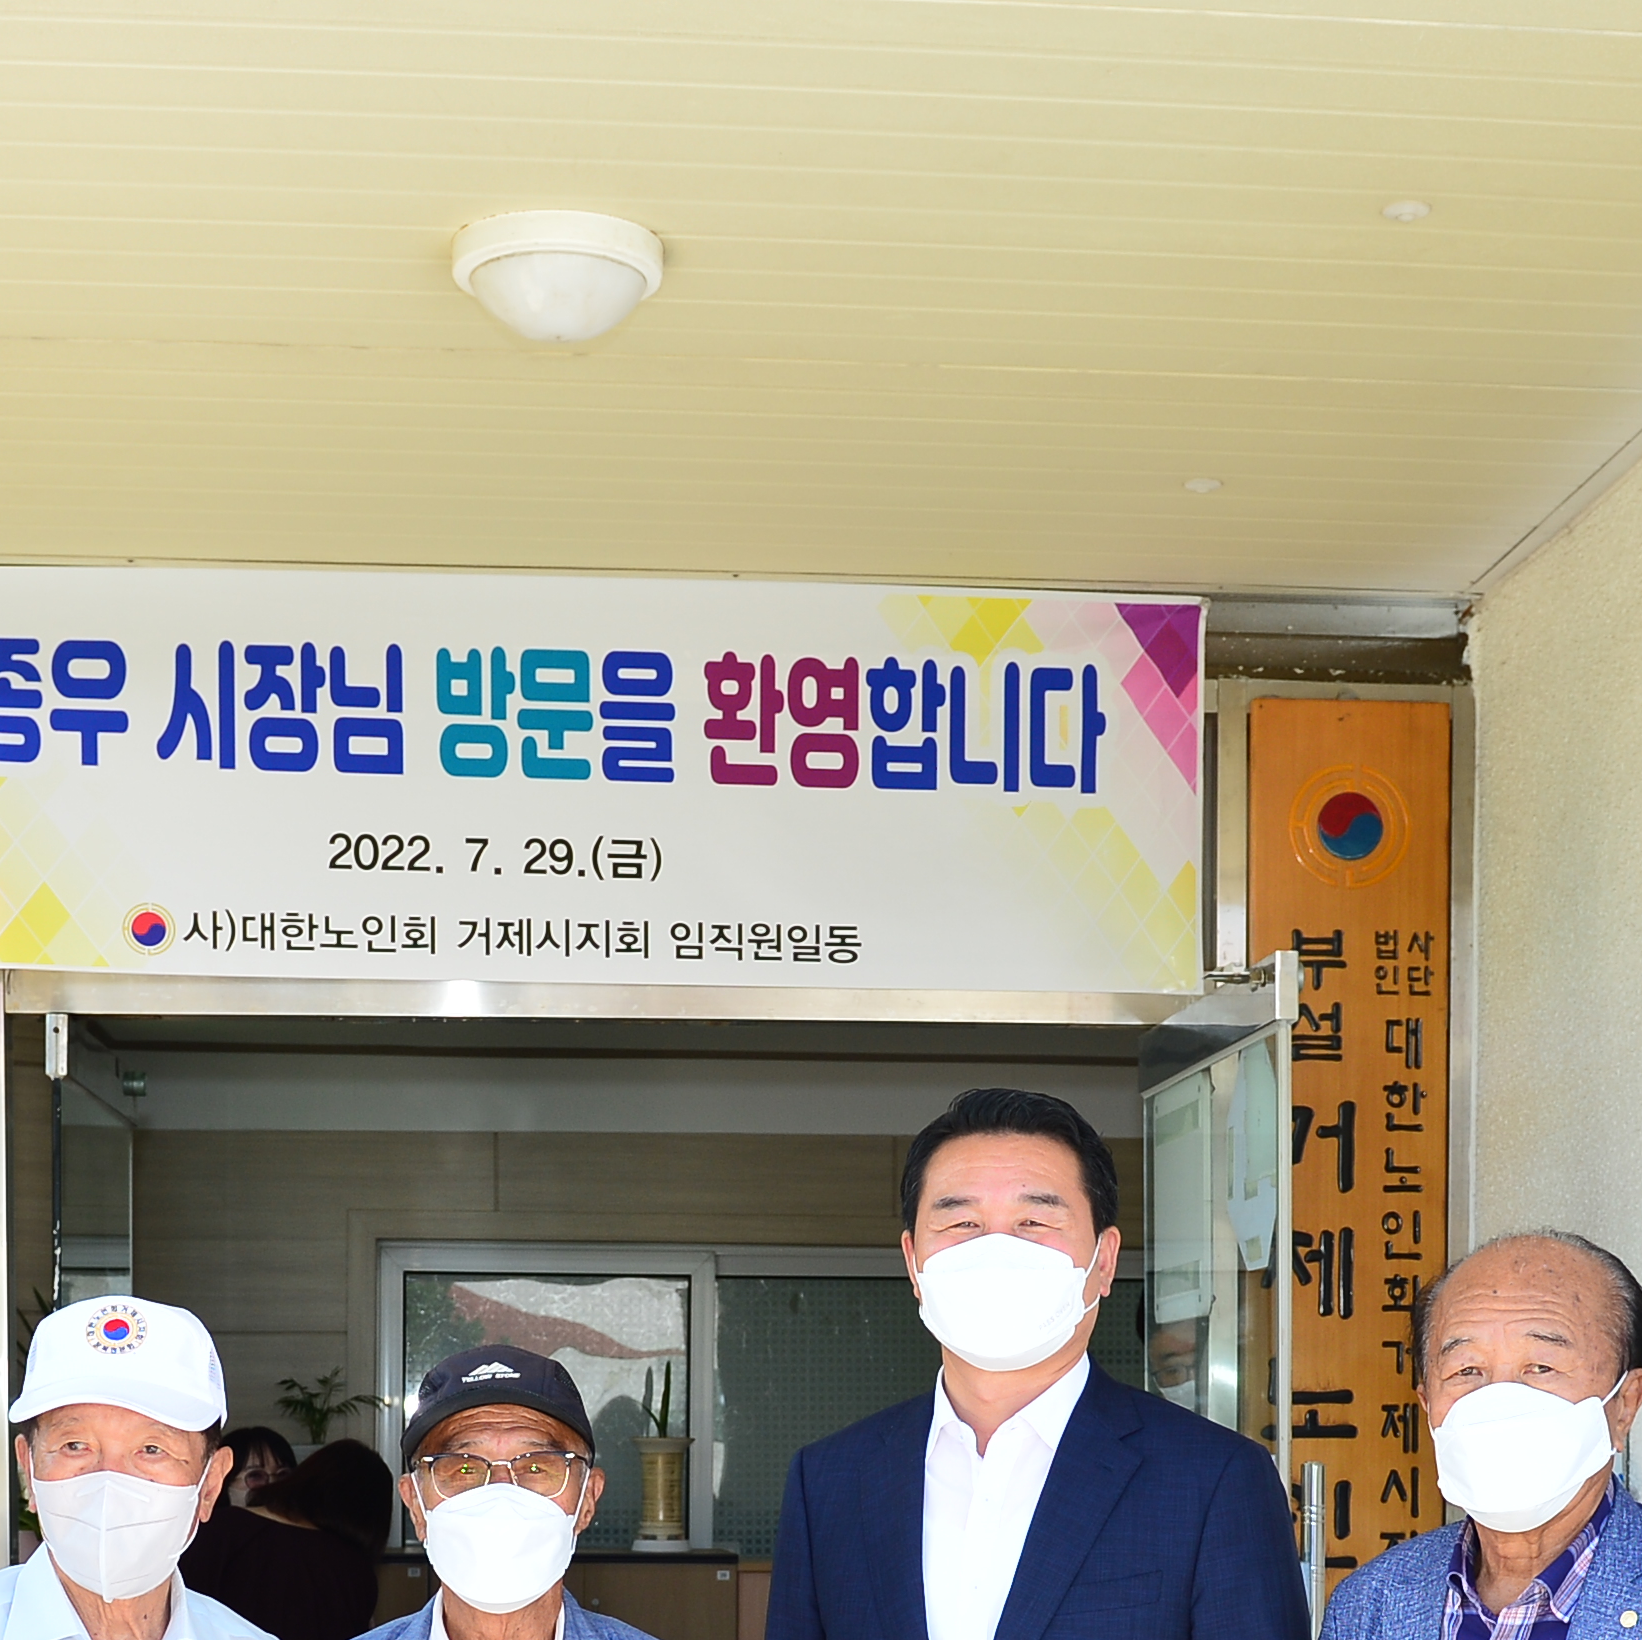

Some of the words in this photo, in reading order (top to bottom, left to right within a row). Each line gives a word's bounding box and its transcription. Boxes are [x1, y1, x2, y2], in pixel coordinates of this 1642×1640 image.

[155, 640, 405, 776] 시장님
[435, 646, 677, 784] 방문을
[702, 650, 1108, 795] 환영합니다
[328, 832, 445, 875] 2022.
[465, 836, 503, 875] 7.
[523, 835, 663, 883] 29.(금)
[183, 909, 437, 956] 사)대한노인회
[457, 917, 650, 960] 거제시지회
[670, 921, 863, 965] 임직원일동
